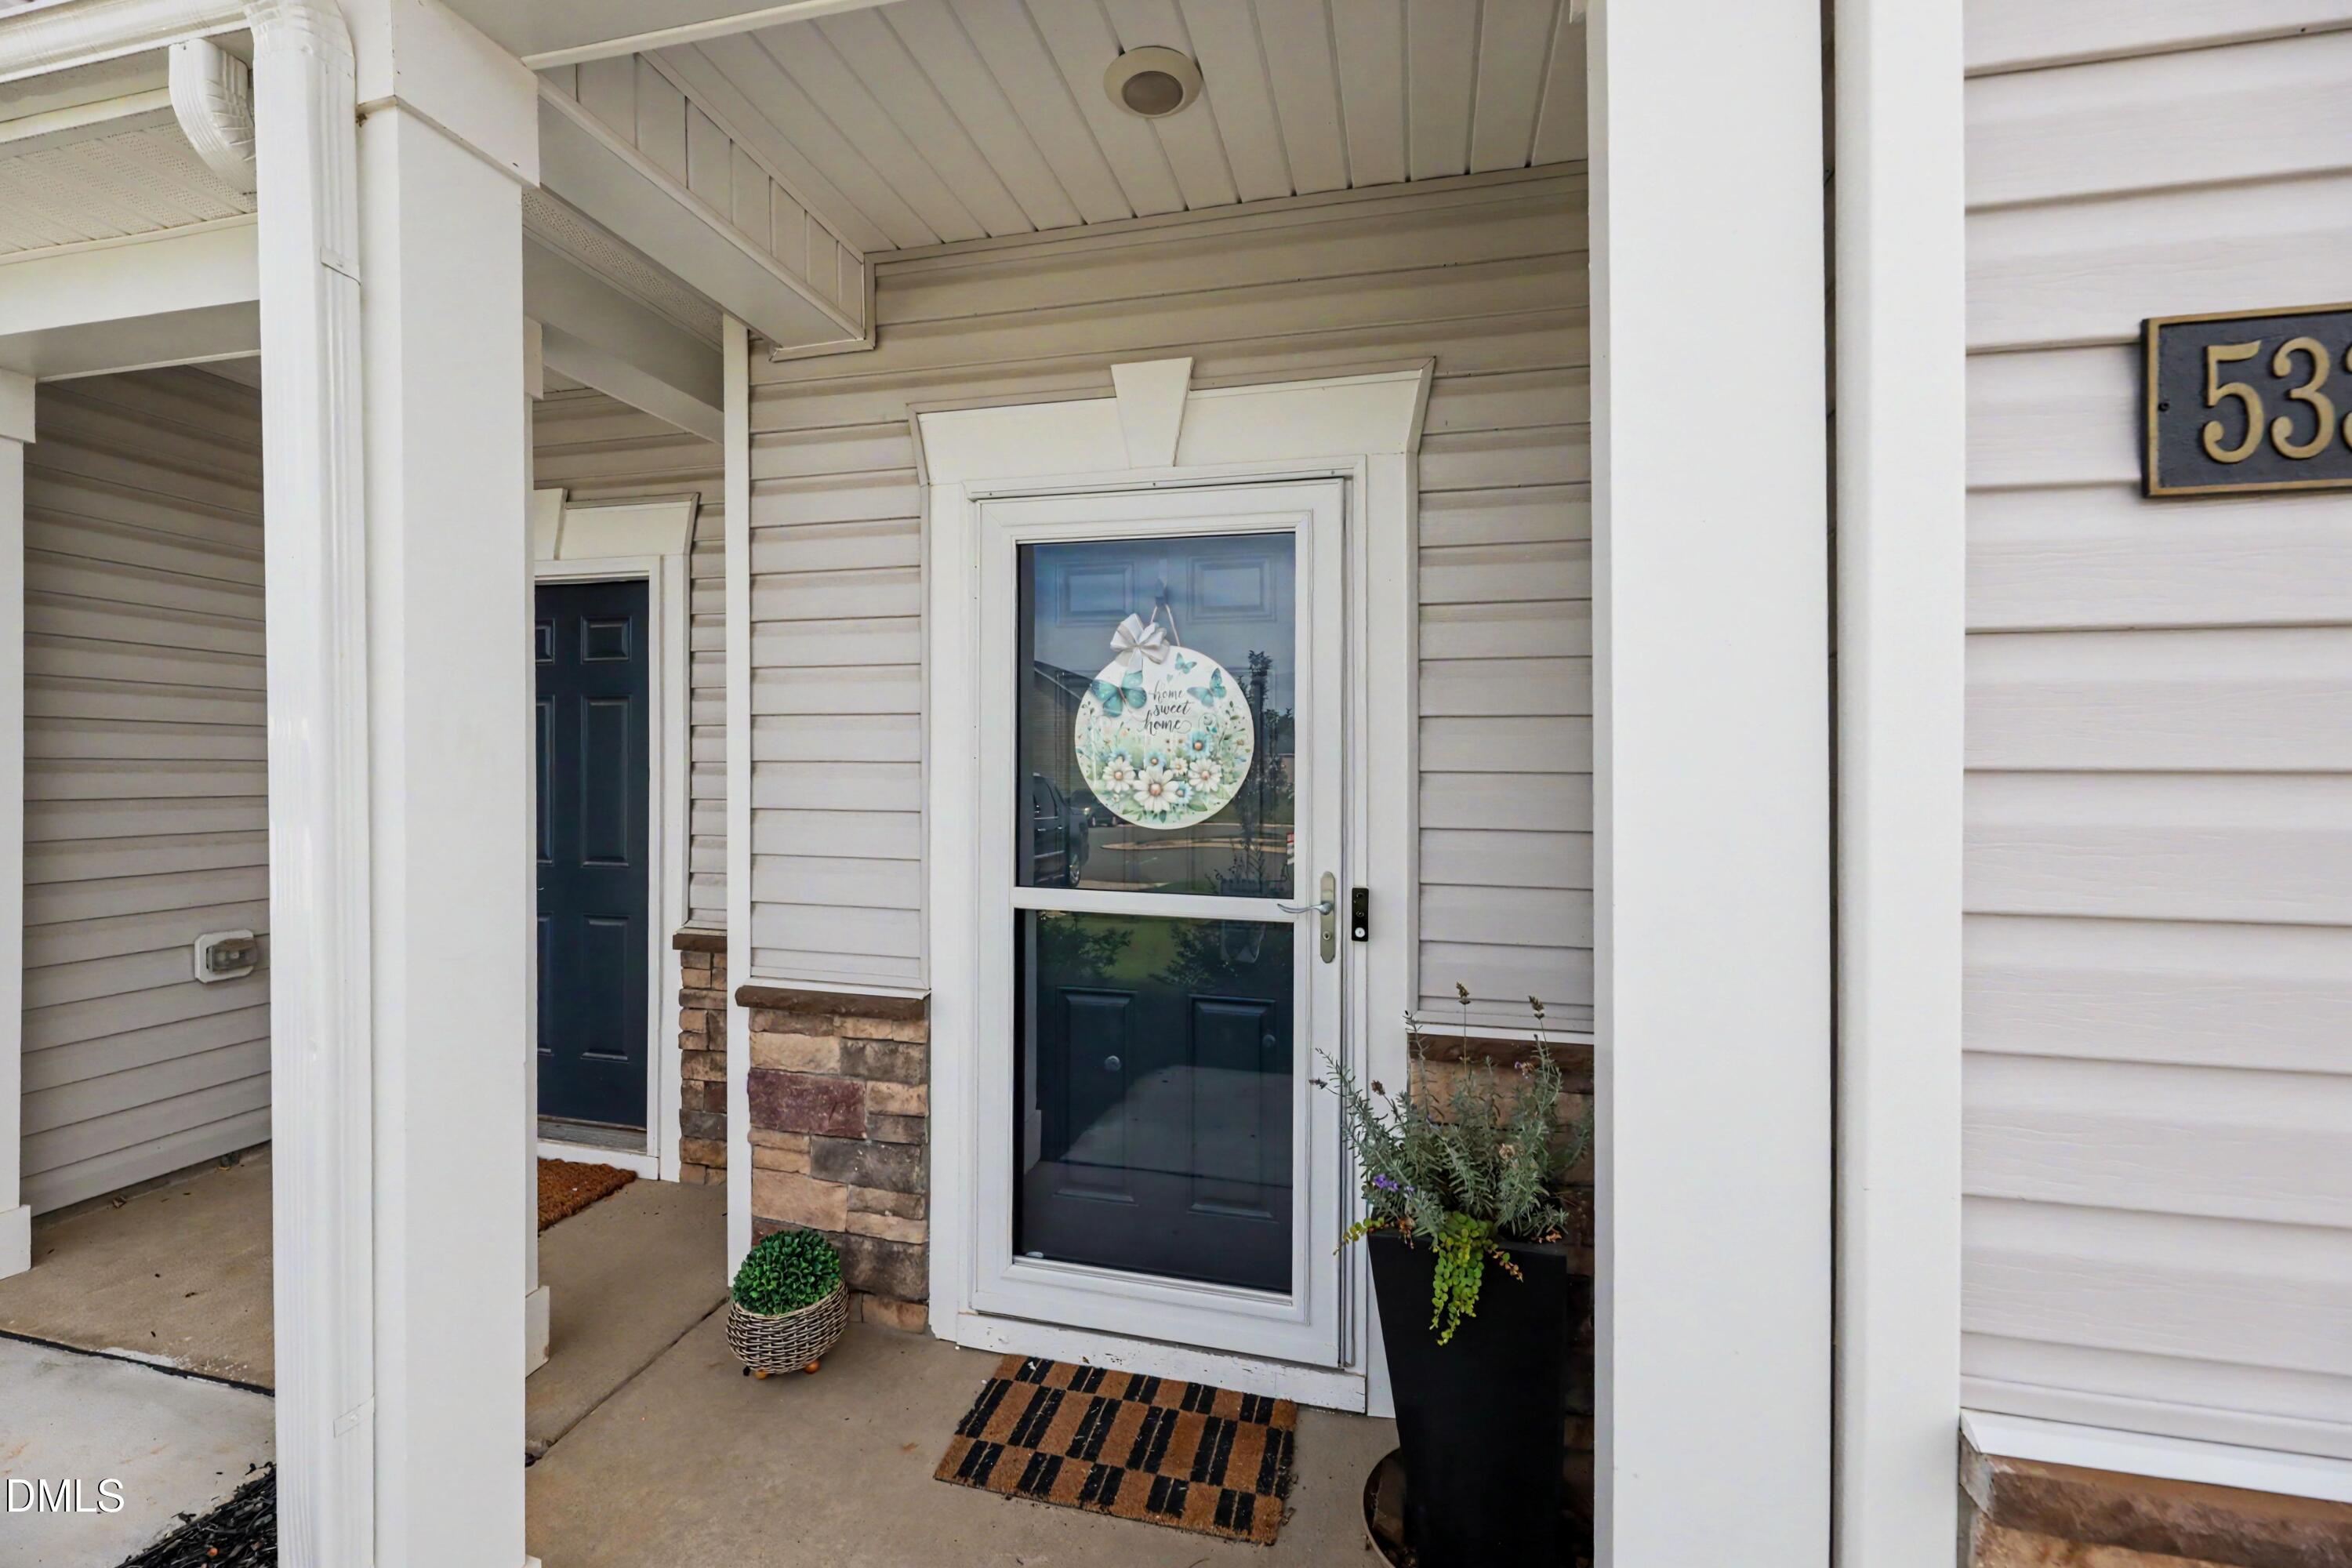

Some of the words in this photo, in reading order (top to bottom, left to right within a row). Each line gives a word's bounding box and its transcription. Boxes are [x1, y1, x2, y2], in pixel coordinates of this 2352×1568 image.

[2203, 336, 2352, 464] 53
[1149, 680, 1182, 703] home
[1153, 700, 1193, 717] sweet
[1138, 710, 1192, 736] home
